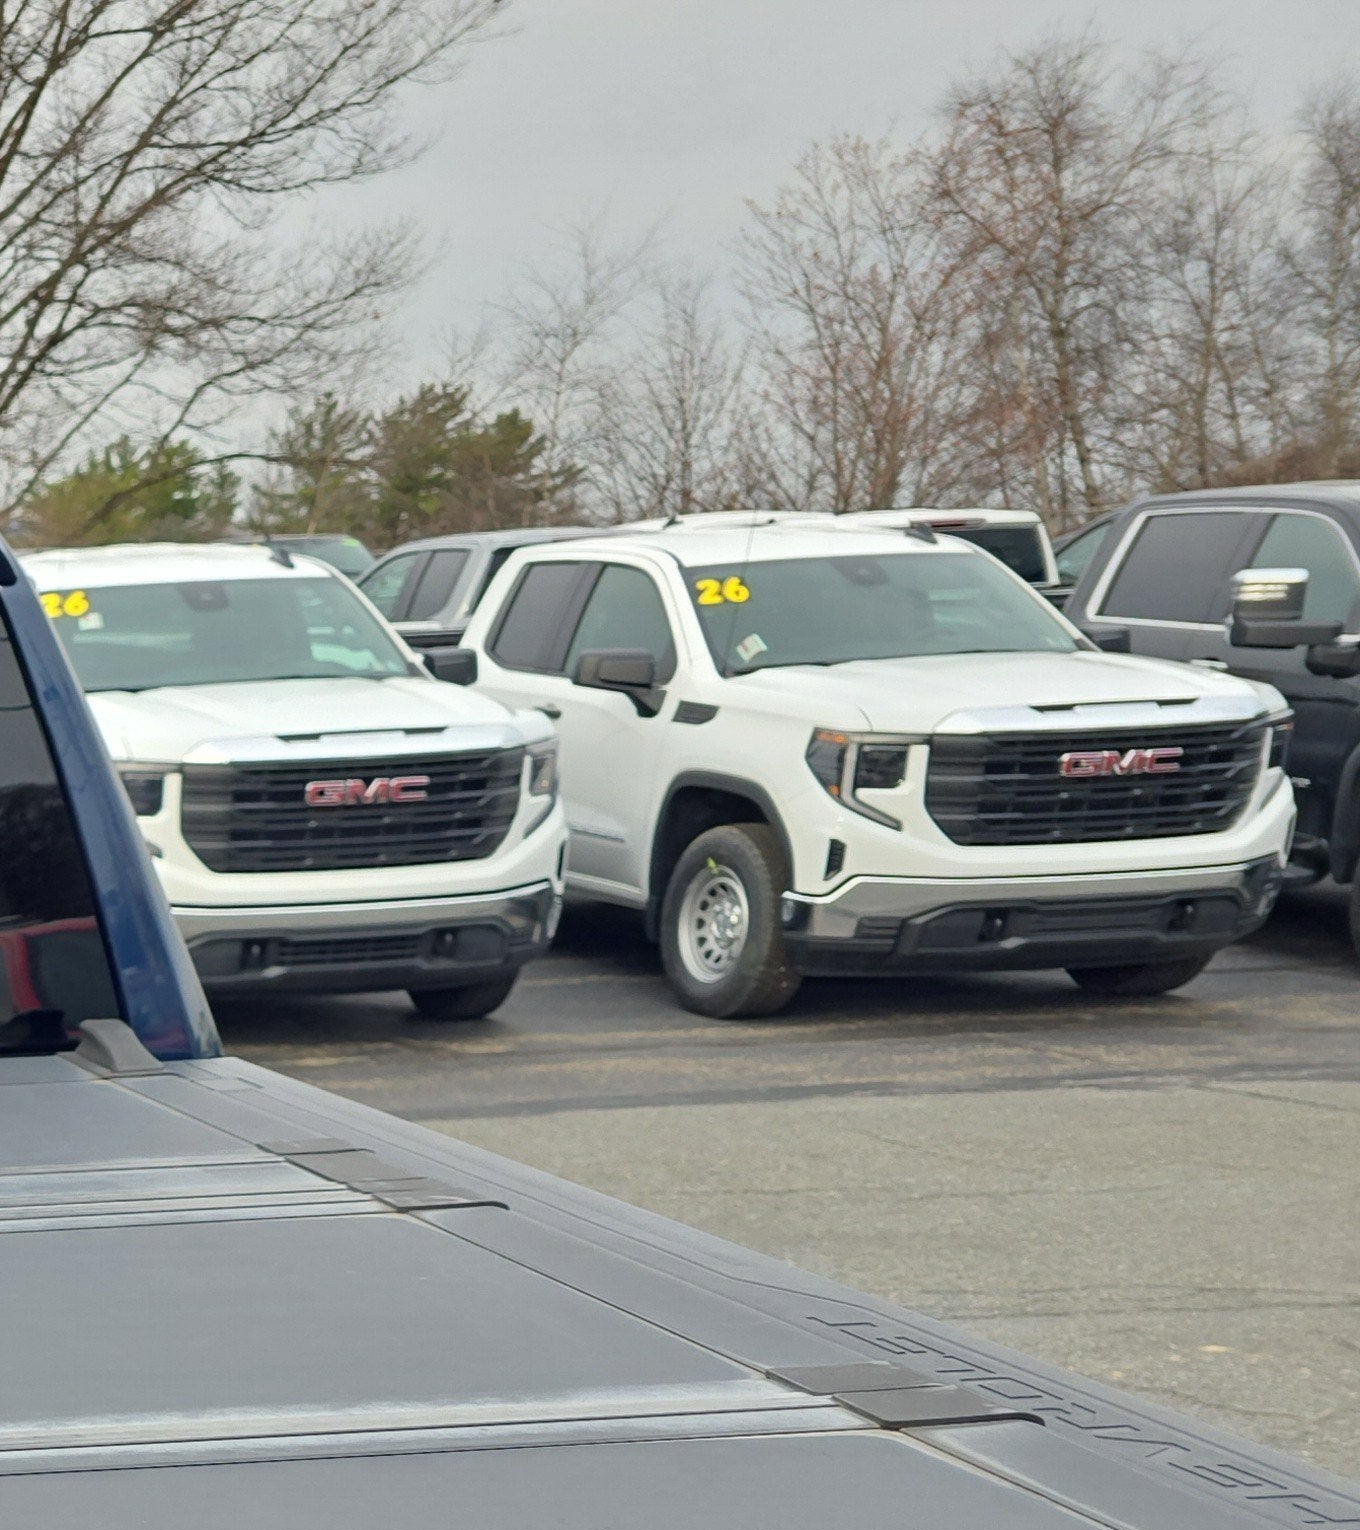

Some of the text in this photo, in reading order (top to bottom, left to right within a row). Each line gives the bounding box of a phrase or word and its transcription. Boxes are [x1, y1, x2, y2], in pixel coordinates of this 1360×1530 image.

[40, 591, 89, 618] 26
[695, 576, 749, 605] 26
[1059, 747, 1184, 778] GMC
[305, 775, 430, 807] GMC
